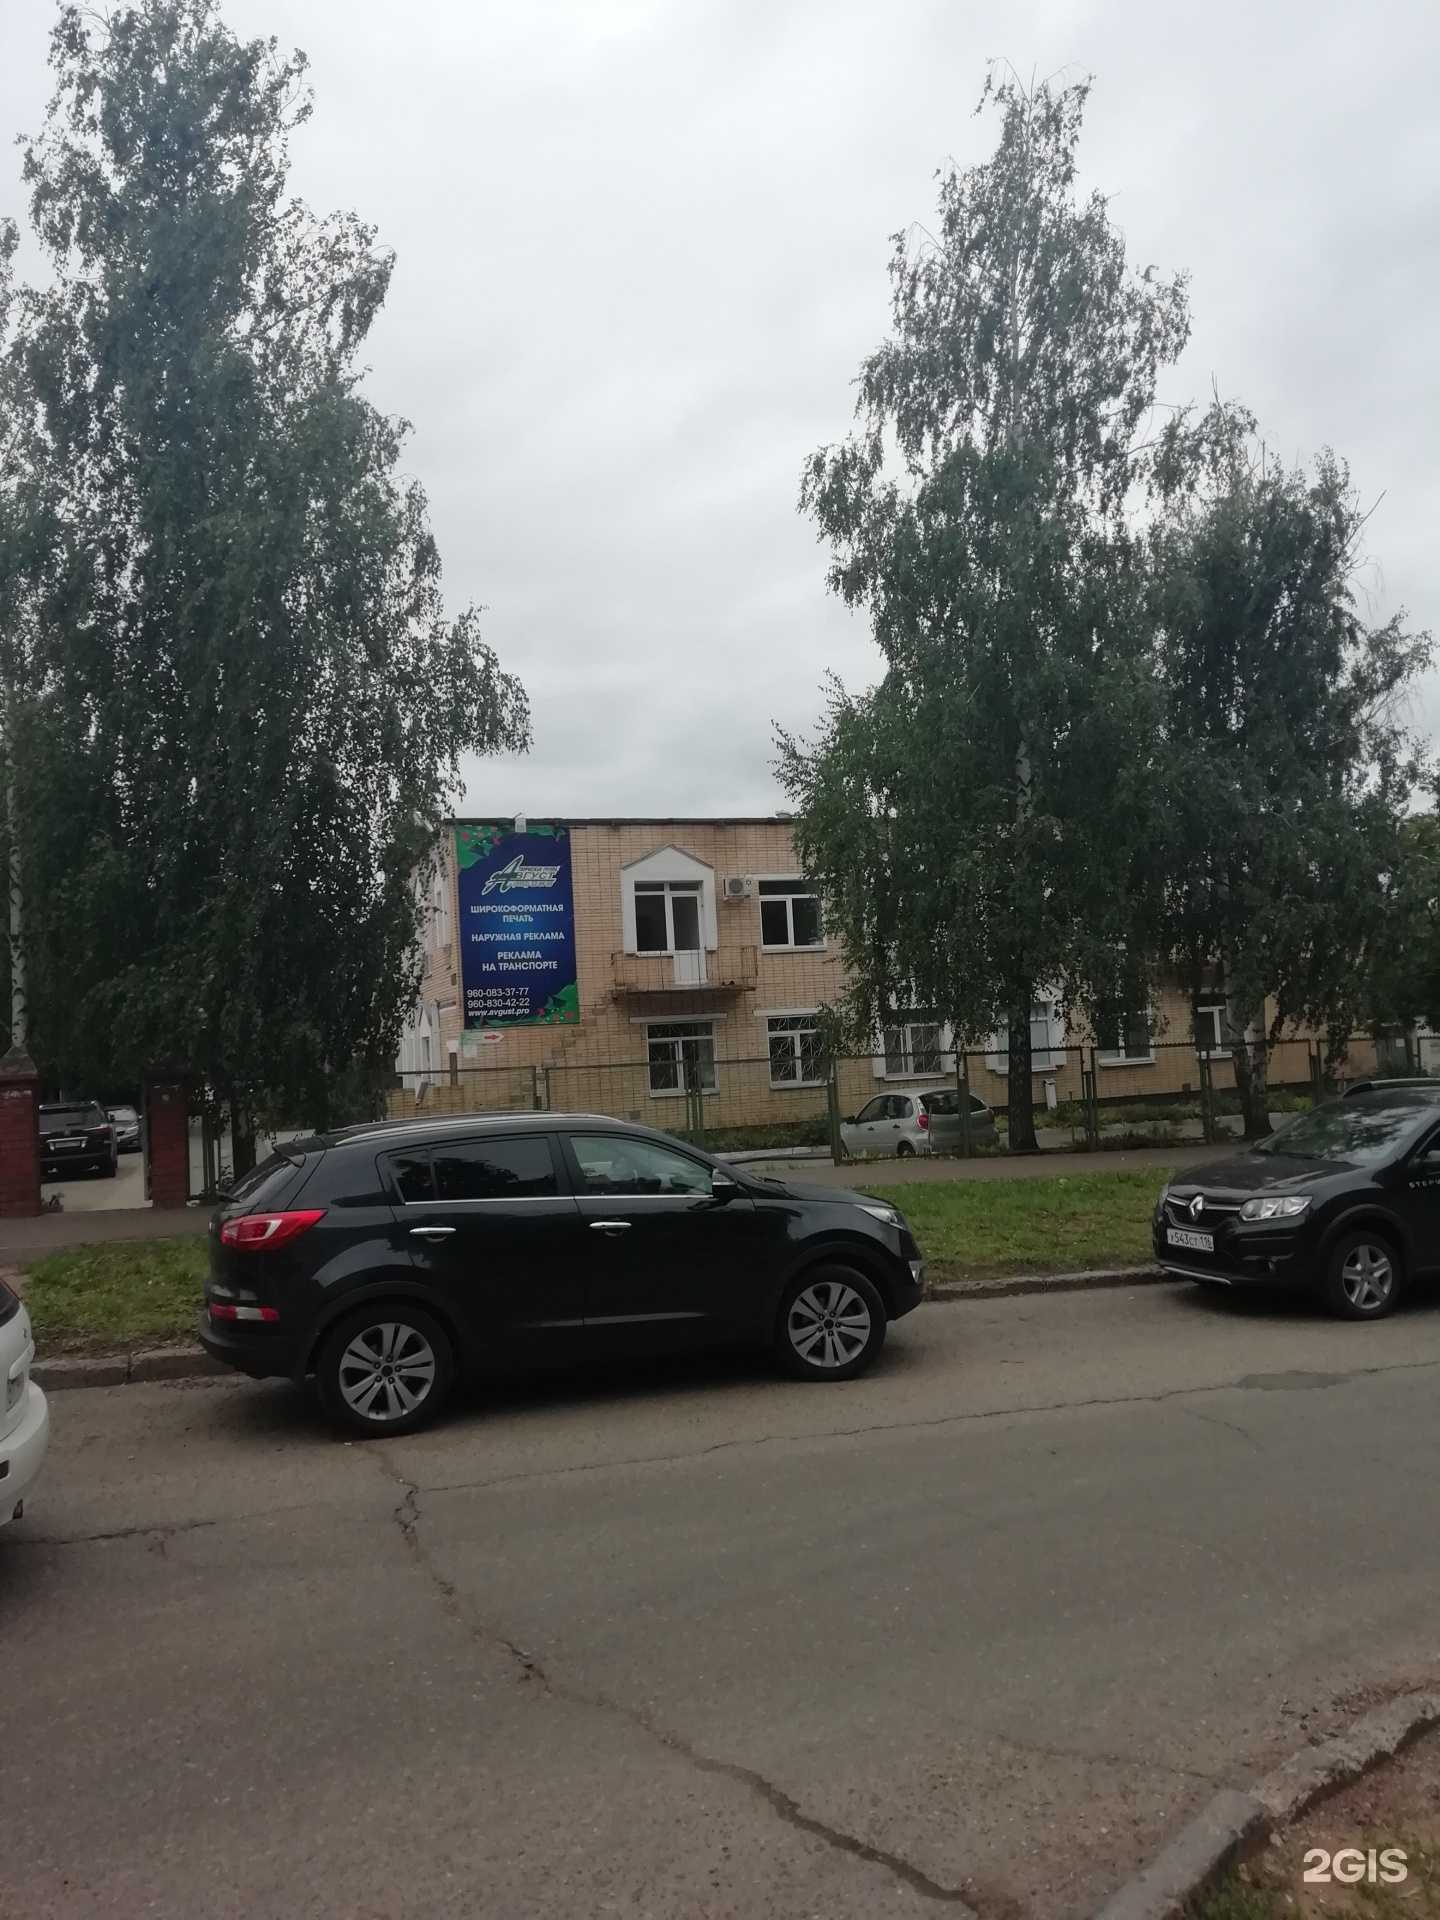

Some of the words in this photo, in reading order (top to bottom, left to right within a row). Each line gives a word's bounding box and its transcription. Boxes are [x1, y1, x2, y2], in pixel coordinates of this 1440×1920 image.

[470, 904, 564, 913] ШИРОКОФОРМАТНАЯ
[502, 914, 534, 923] ПЕЧАТЬ
[471, 933, 521, 942] НАРУЖНАЯ
[524, 932, 565, 941] РЕКЛАМА
[497, 951, 542, 960] РЕКЛАМА
[482, 963, 496, 971] НА
[498, 961, 558, 970] ТРАНСПОРТЕ
[467, 988, 529, 998] 960-083-37-77
[467, 998, 530, 1008] 960-830-42-22
[468, 1008, 530, 1018] www.avgust.pro
